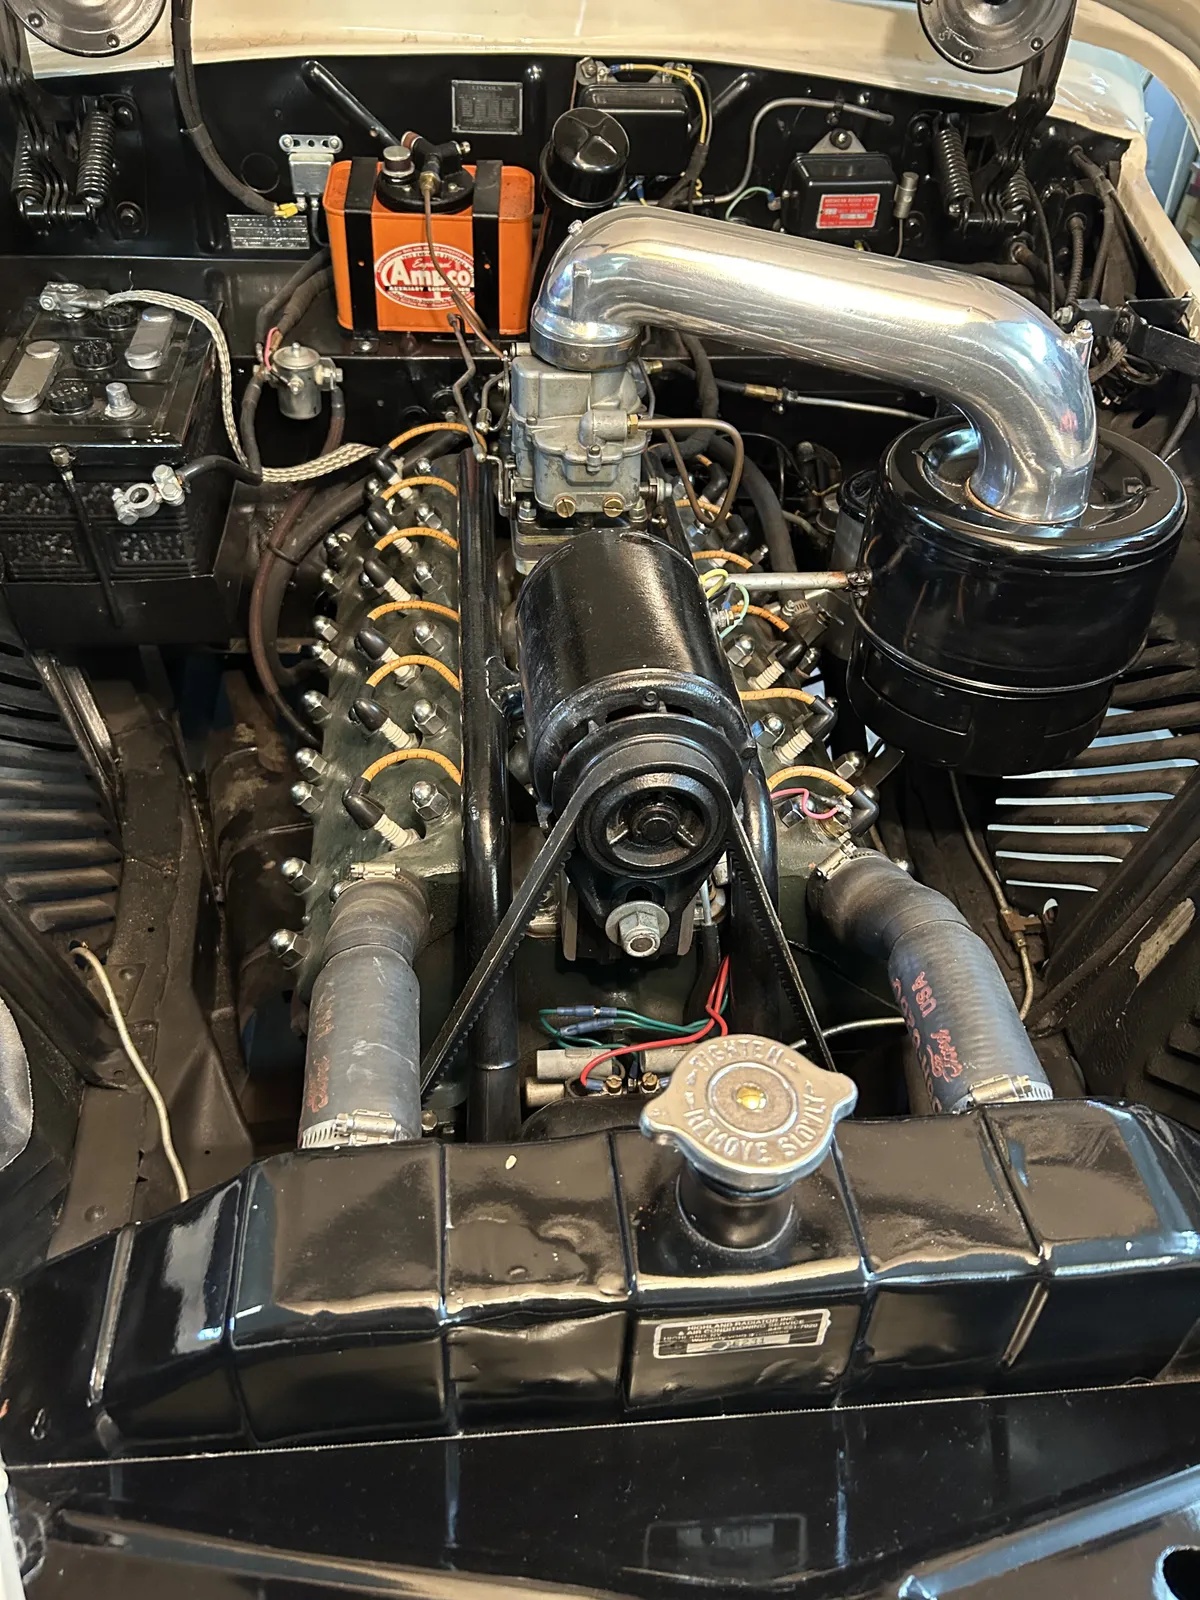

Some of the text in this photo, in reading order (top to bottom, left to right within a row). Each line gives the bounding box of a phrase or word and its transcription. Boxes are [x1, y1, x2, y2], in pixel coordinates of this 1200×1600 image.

[381, 259, 471, 300] Ampco
[911, 971, 937, 1018] USA
[688, 1039, 784, 1072] TIGHTEN
[683, 1108, 773, 1163] REMOVE
[777, 1093, 828, 1157] SLOWLY
[687, 1322, 733, 1331] HIGHLAND
[735, 1318, 779, 1327] RADIATOR
[768, 1319, 805, 1328] SERVICE
